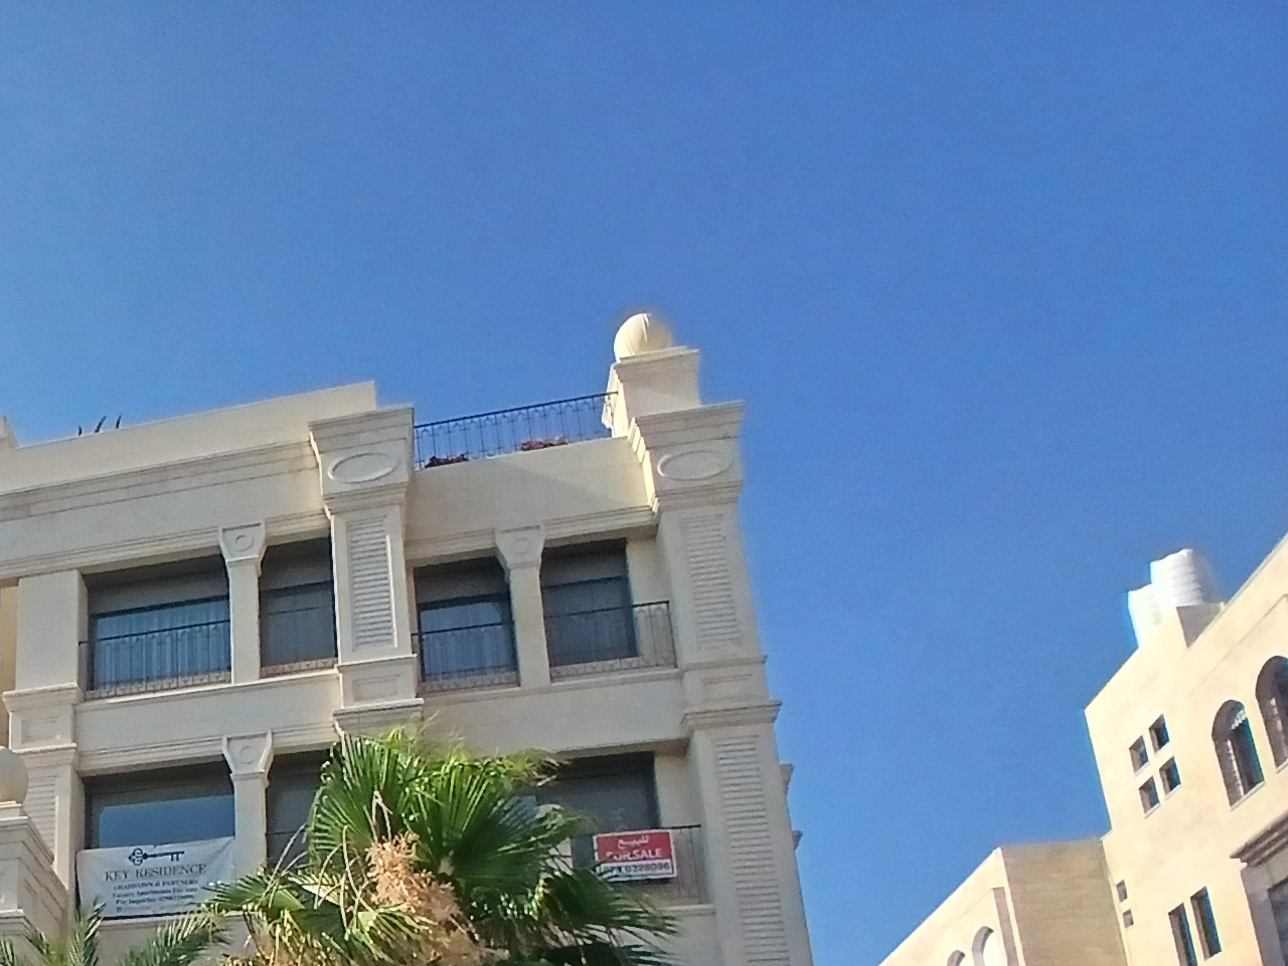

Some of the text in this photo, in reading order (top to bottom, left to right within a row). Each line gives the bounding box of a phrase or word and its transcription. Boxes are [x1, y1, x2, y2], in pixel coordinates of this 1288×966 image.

[632, 848, 663, 860] SALE
[105, 864, 206, 881] KEY RESIDENCE
